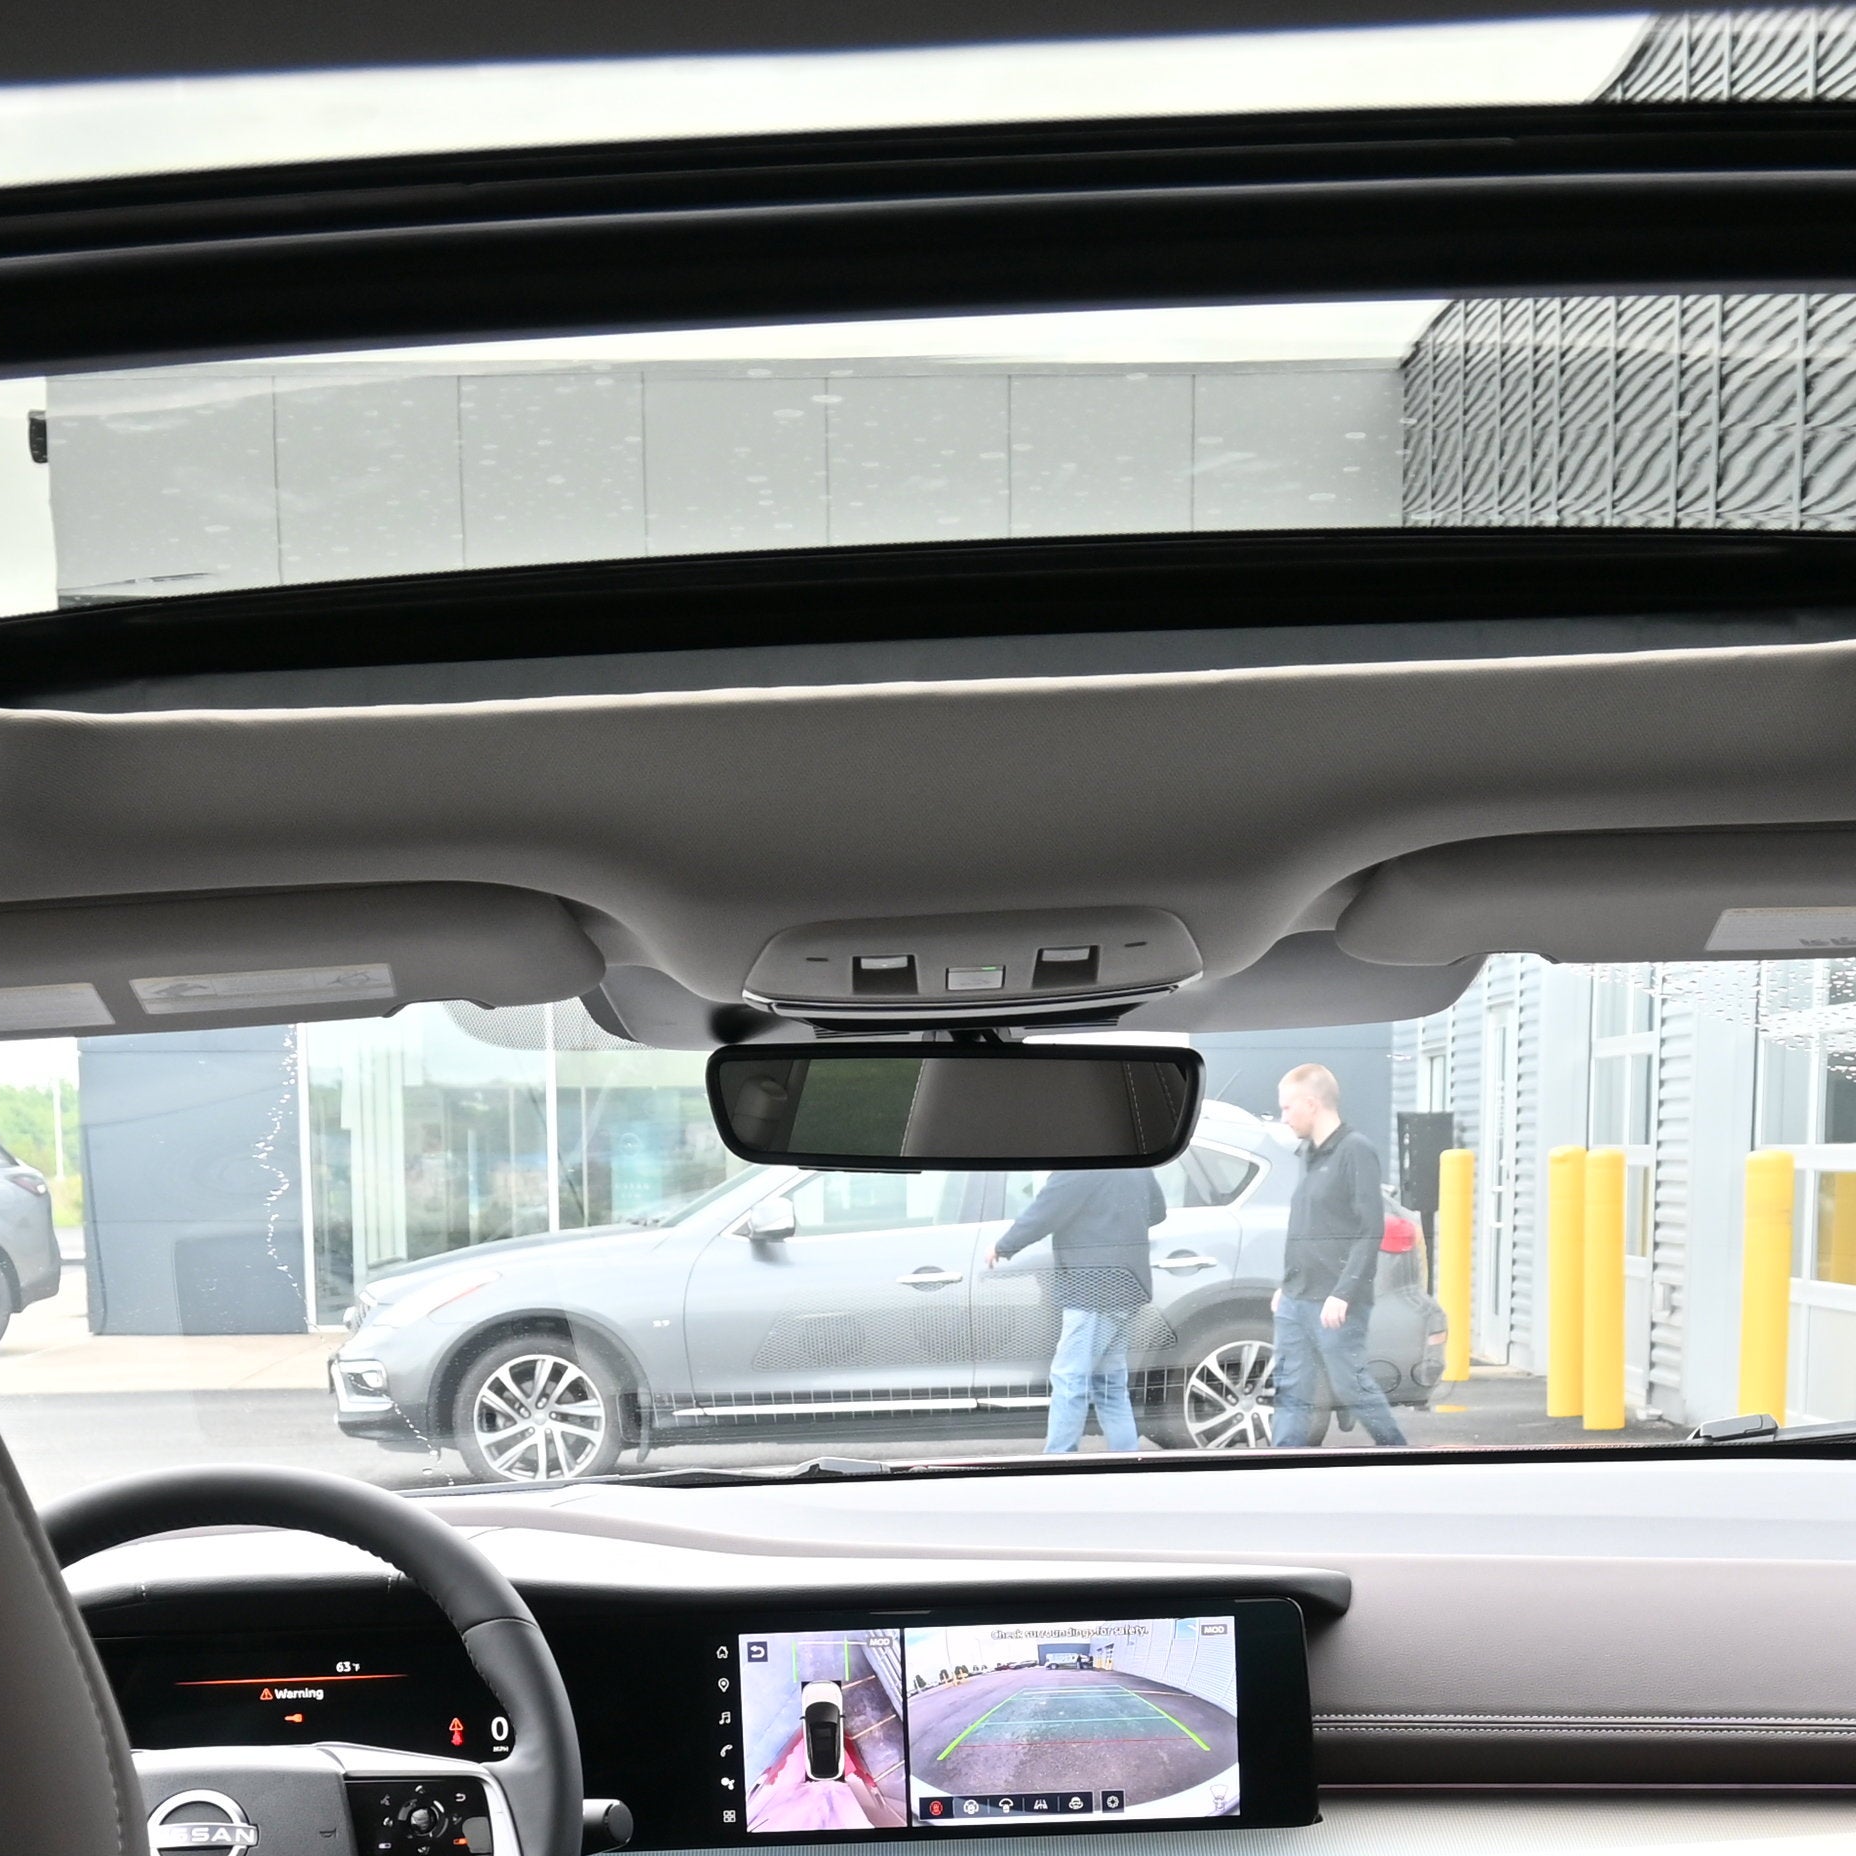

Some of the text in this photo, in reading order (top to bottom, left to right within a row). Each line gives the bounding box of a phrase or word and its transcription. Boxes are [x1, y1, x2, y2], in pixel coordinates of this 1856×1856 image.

[991, 1624, 1150, 1640] Check surroundings for safety.
[1203, 1625, 1225, 1634] MOD
[869, 1638, 890, 1647] MOD
[274, 1688, 325, 1701] Warning
[491, 1716, 509, 1741] 0
